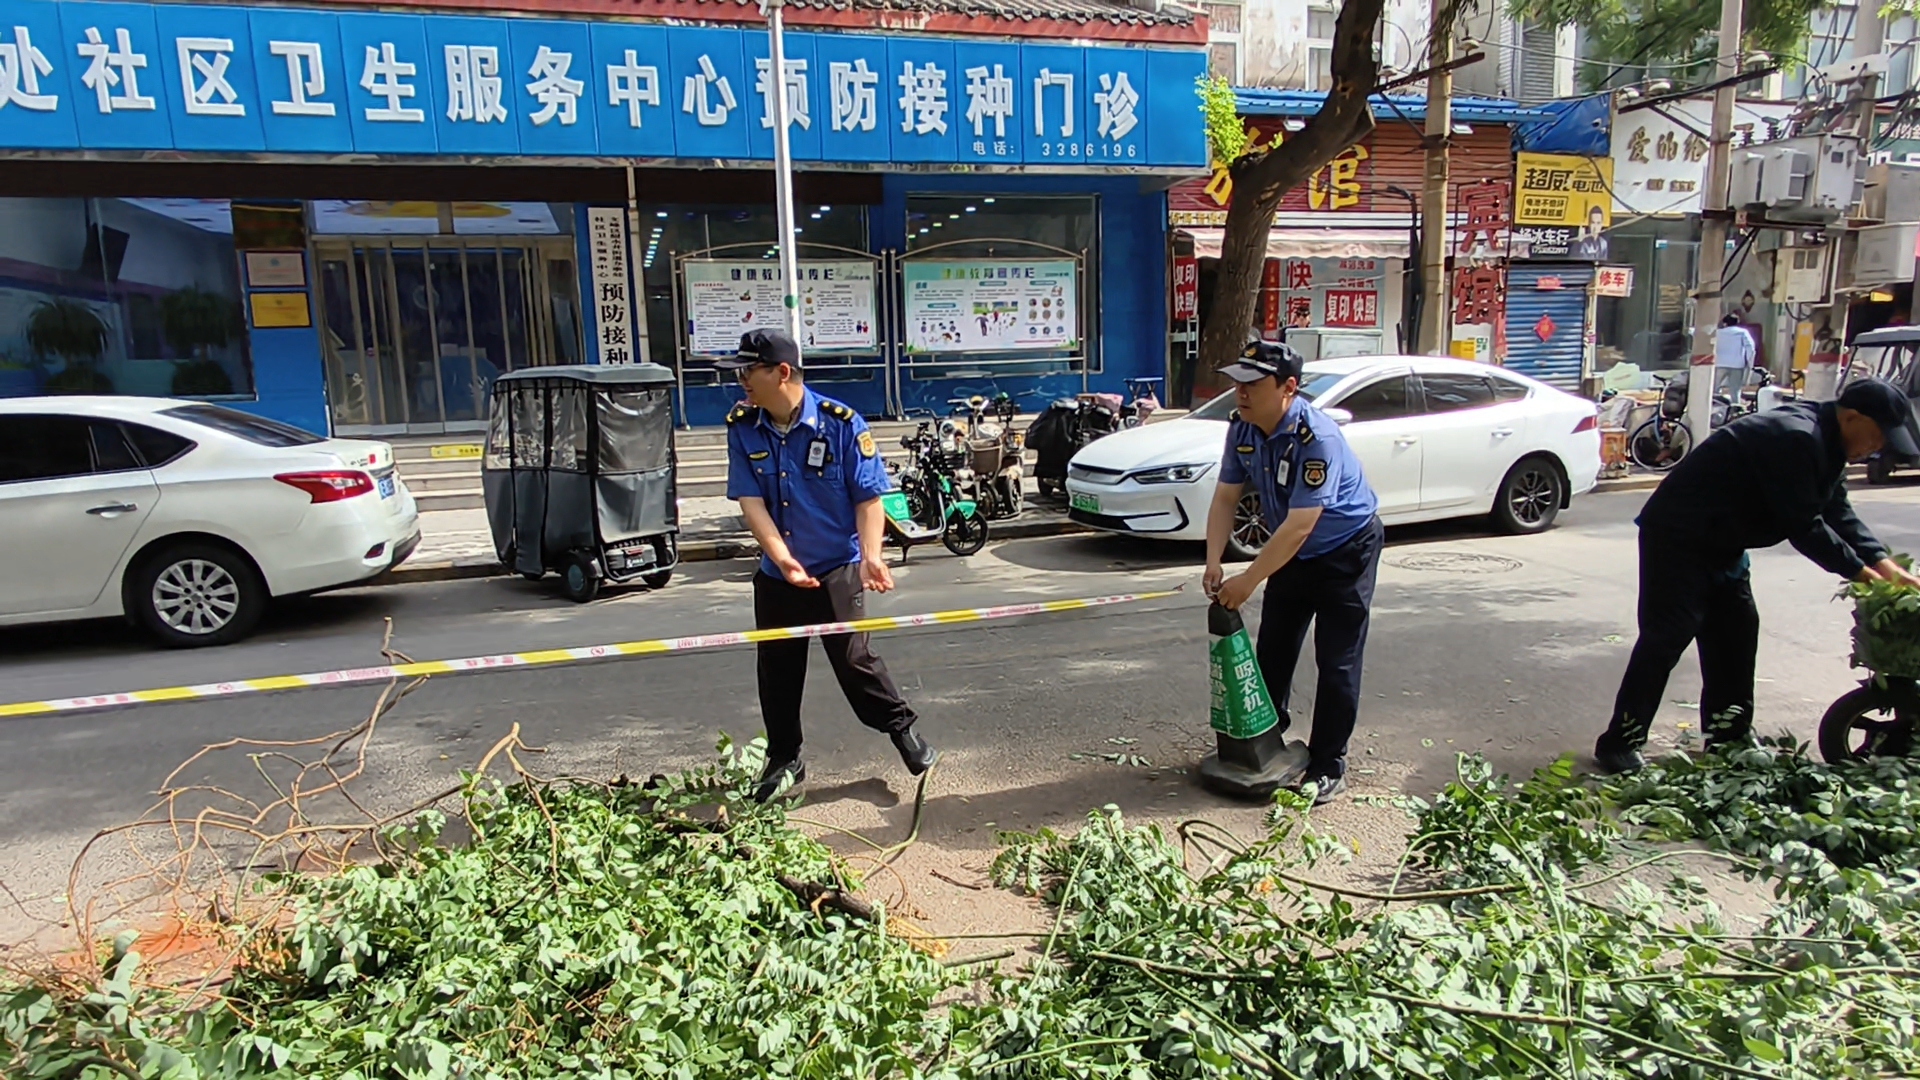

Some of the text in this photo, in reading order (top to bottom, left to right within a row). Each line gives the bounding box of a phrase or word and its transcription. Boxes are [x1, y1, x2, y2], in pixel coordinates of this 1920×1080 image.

[0, 26, 1140, 142] 处社区卫生服务中心预防接种门诊
[973, 141, 1137, 157] 电话: 3386196
[1453, 181, 1511, 325] 宾馆
[731, 268, 834, 281] 健康教传栏
[1600, 271, 1625, 287] 修车
[600, 283, 629, 366] 预防接种
[1326, 294, 1377, 322] 复印快照
[1233, 658, 1264, 713] 晾衣机
